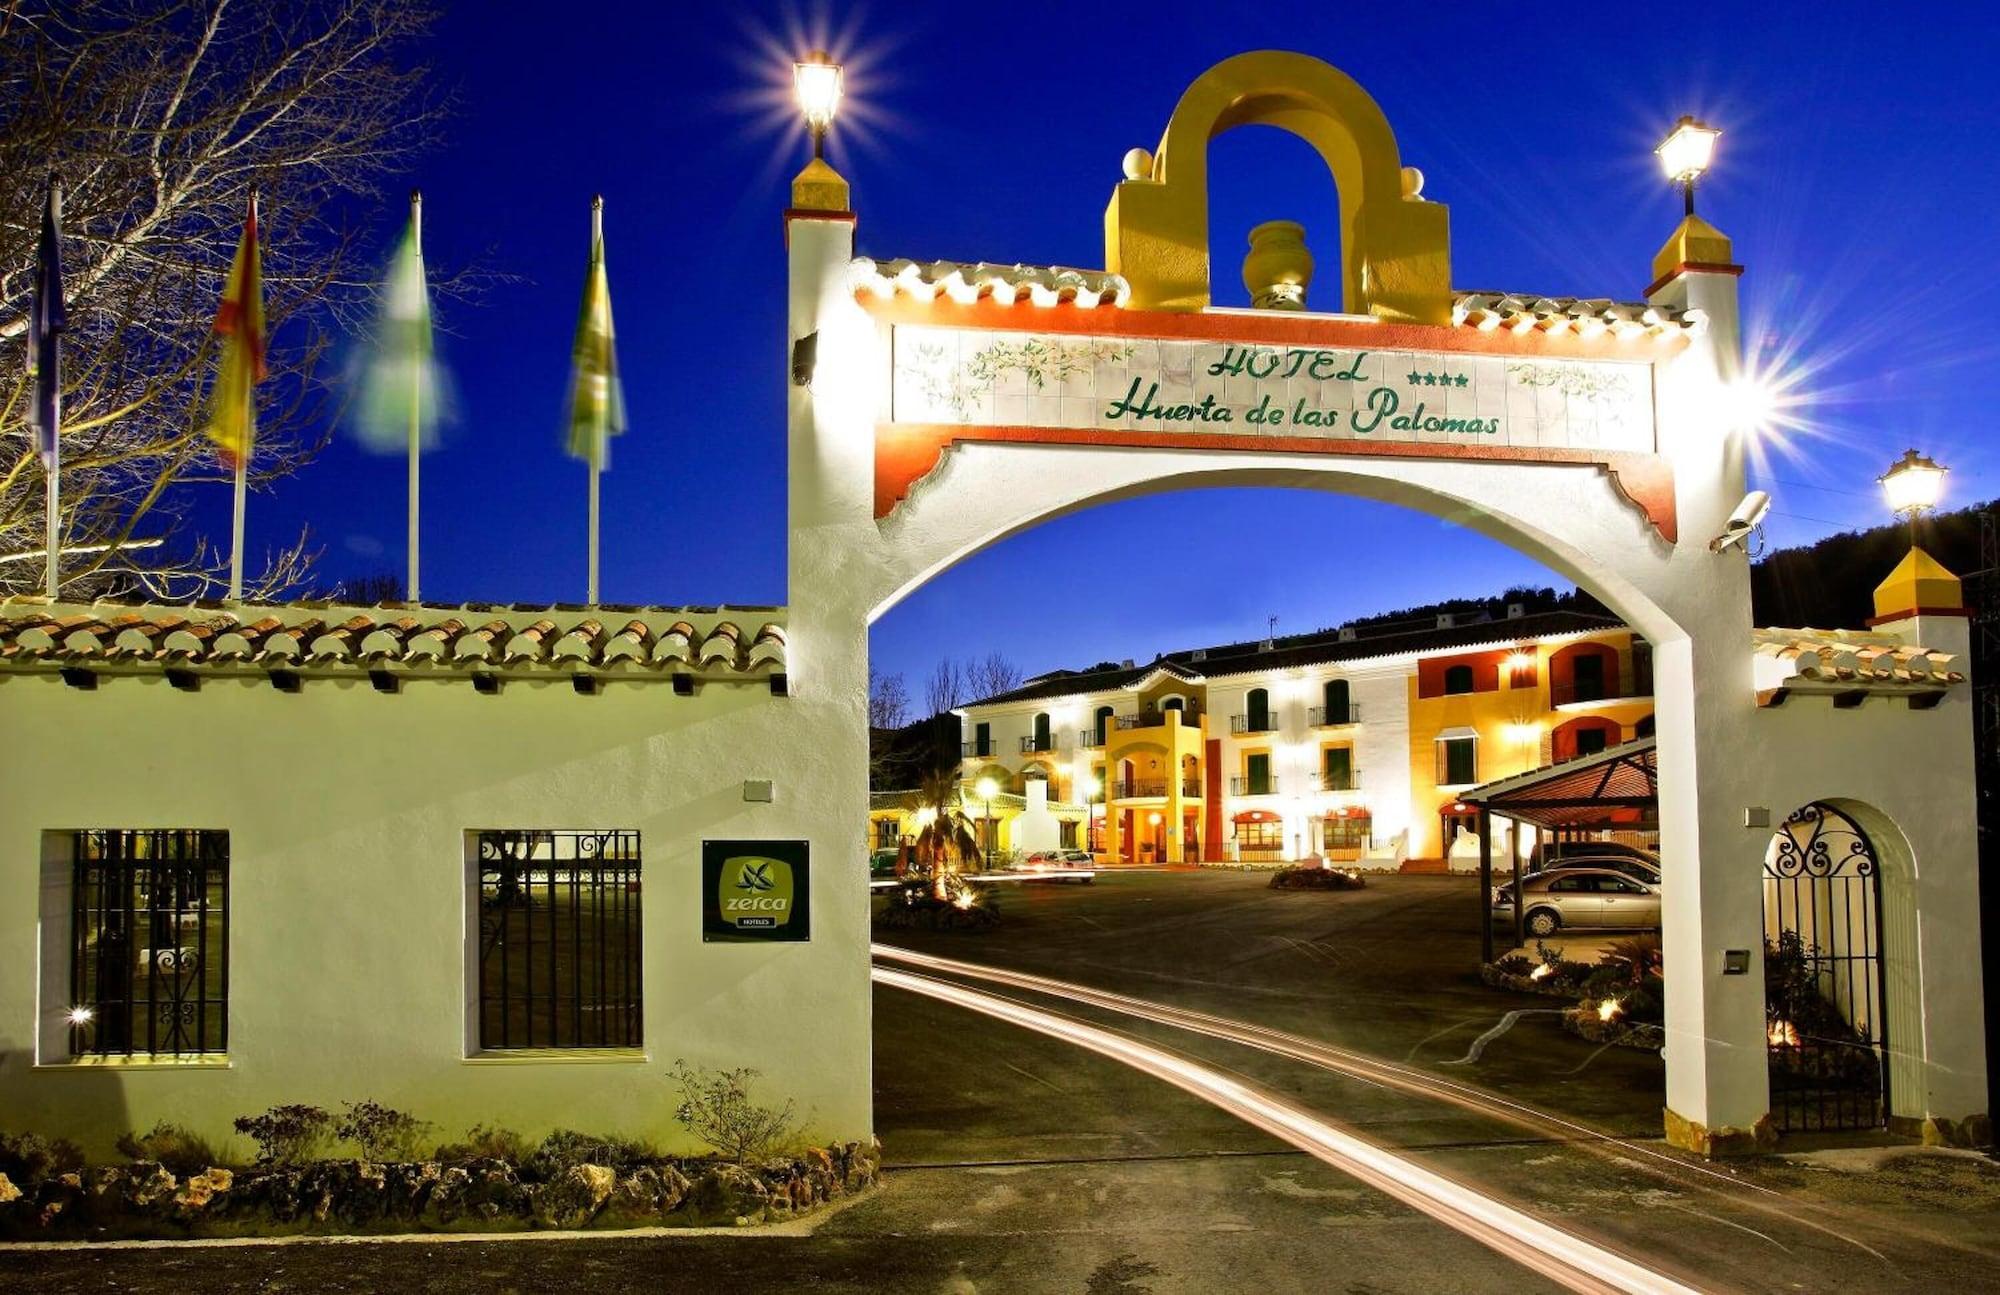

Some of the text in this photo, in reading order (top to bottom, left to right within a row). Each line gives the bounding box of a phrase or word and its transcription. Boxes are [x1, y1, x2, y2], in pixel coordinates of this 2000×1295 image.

[1207, 347, 1369, 381] HOTEL
[1105, 376, 1500, 435] Huerta de las Palomas
